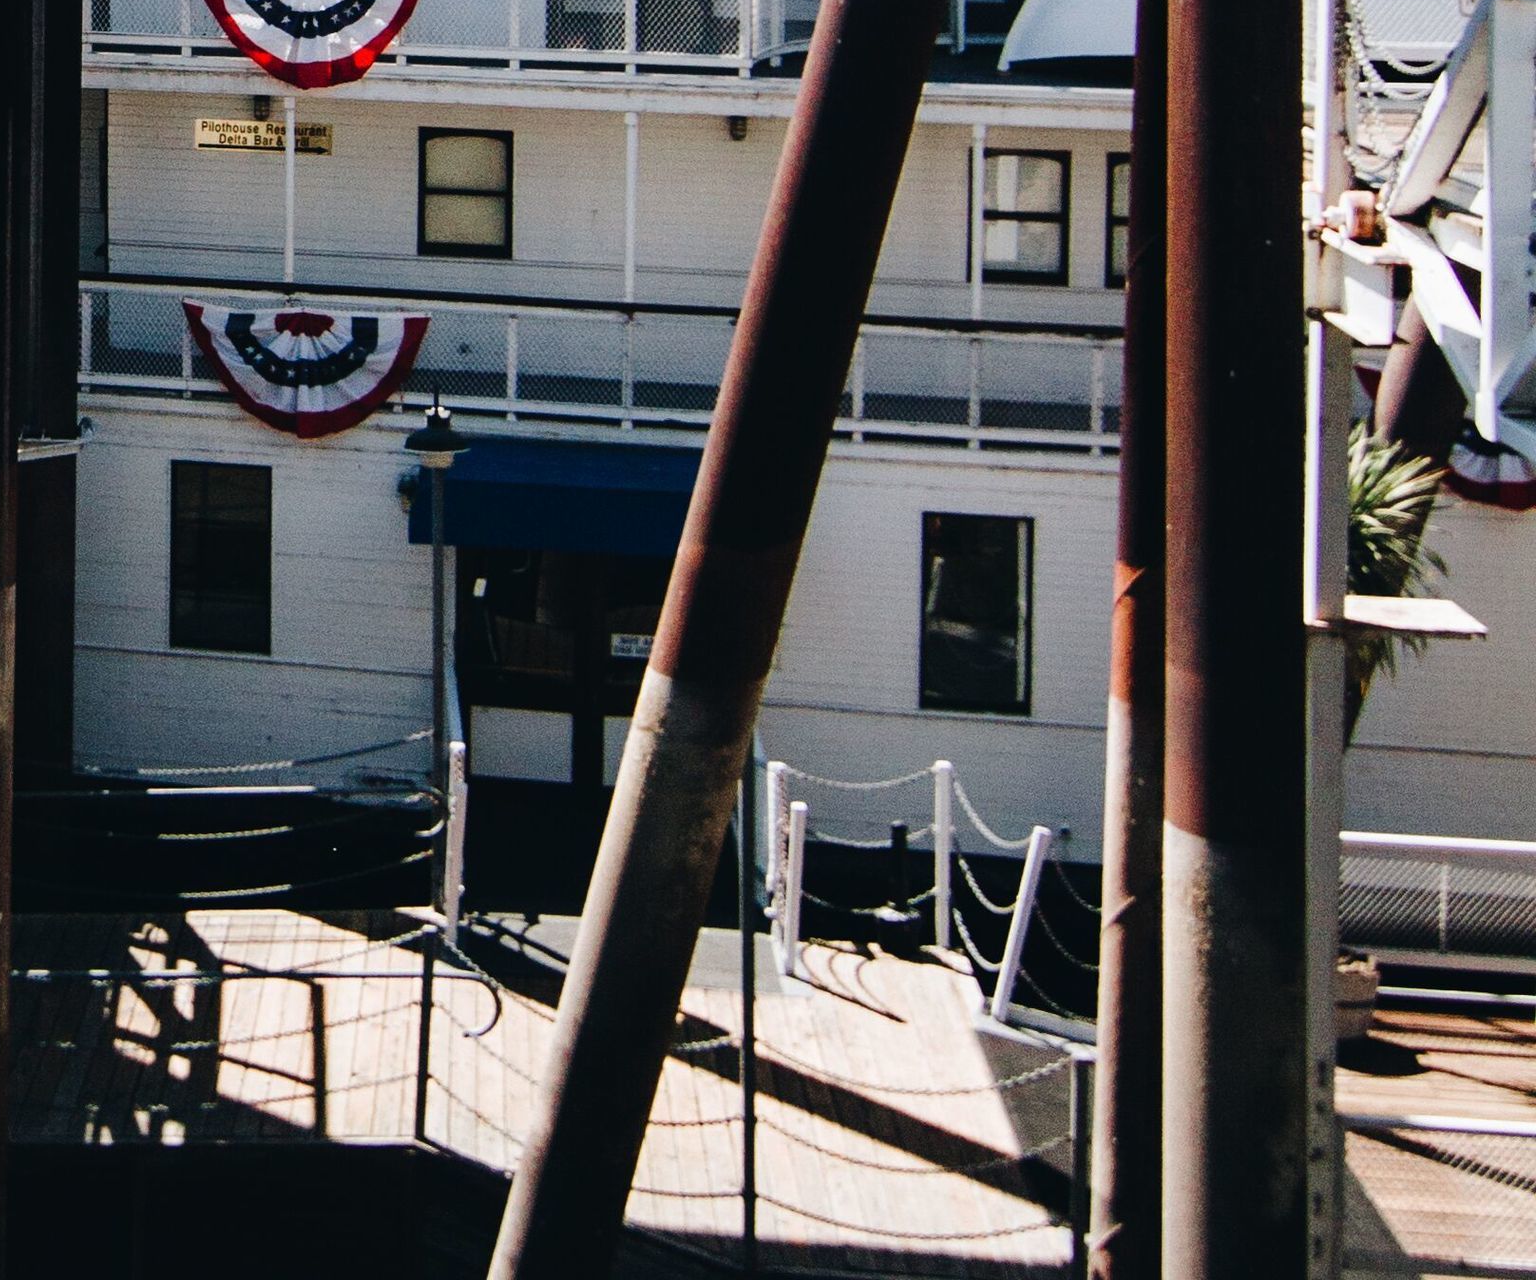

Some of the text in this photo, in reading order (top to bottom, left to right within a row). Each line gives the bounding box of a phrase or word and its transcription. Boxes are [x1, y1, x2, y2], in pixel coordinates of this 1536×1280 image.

[201, 121, 327, 137] Pilothouse Resurant
[218, 133, 248, 145] Delta
[254, 135, 273, 146] Bar
